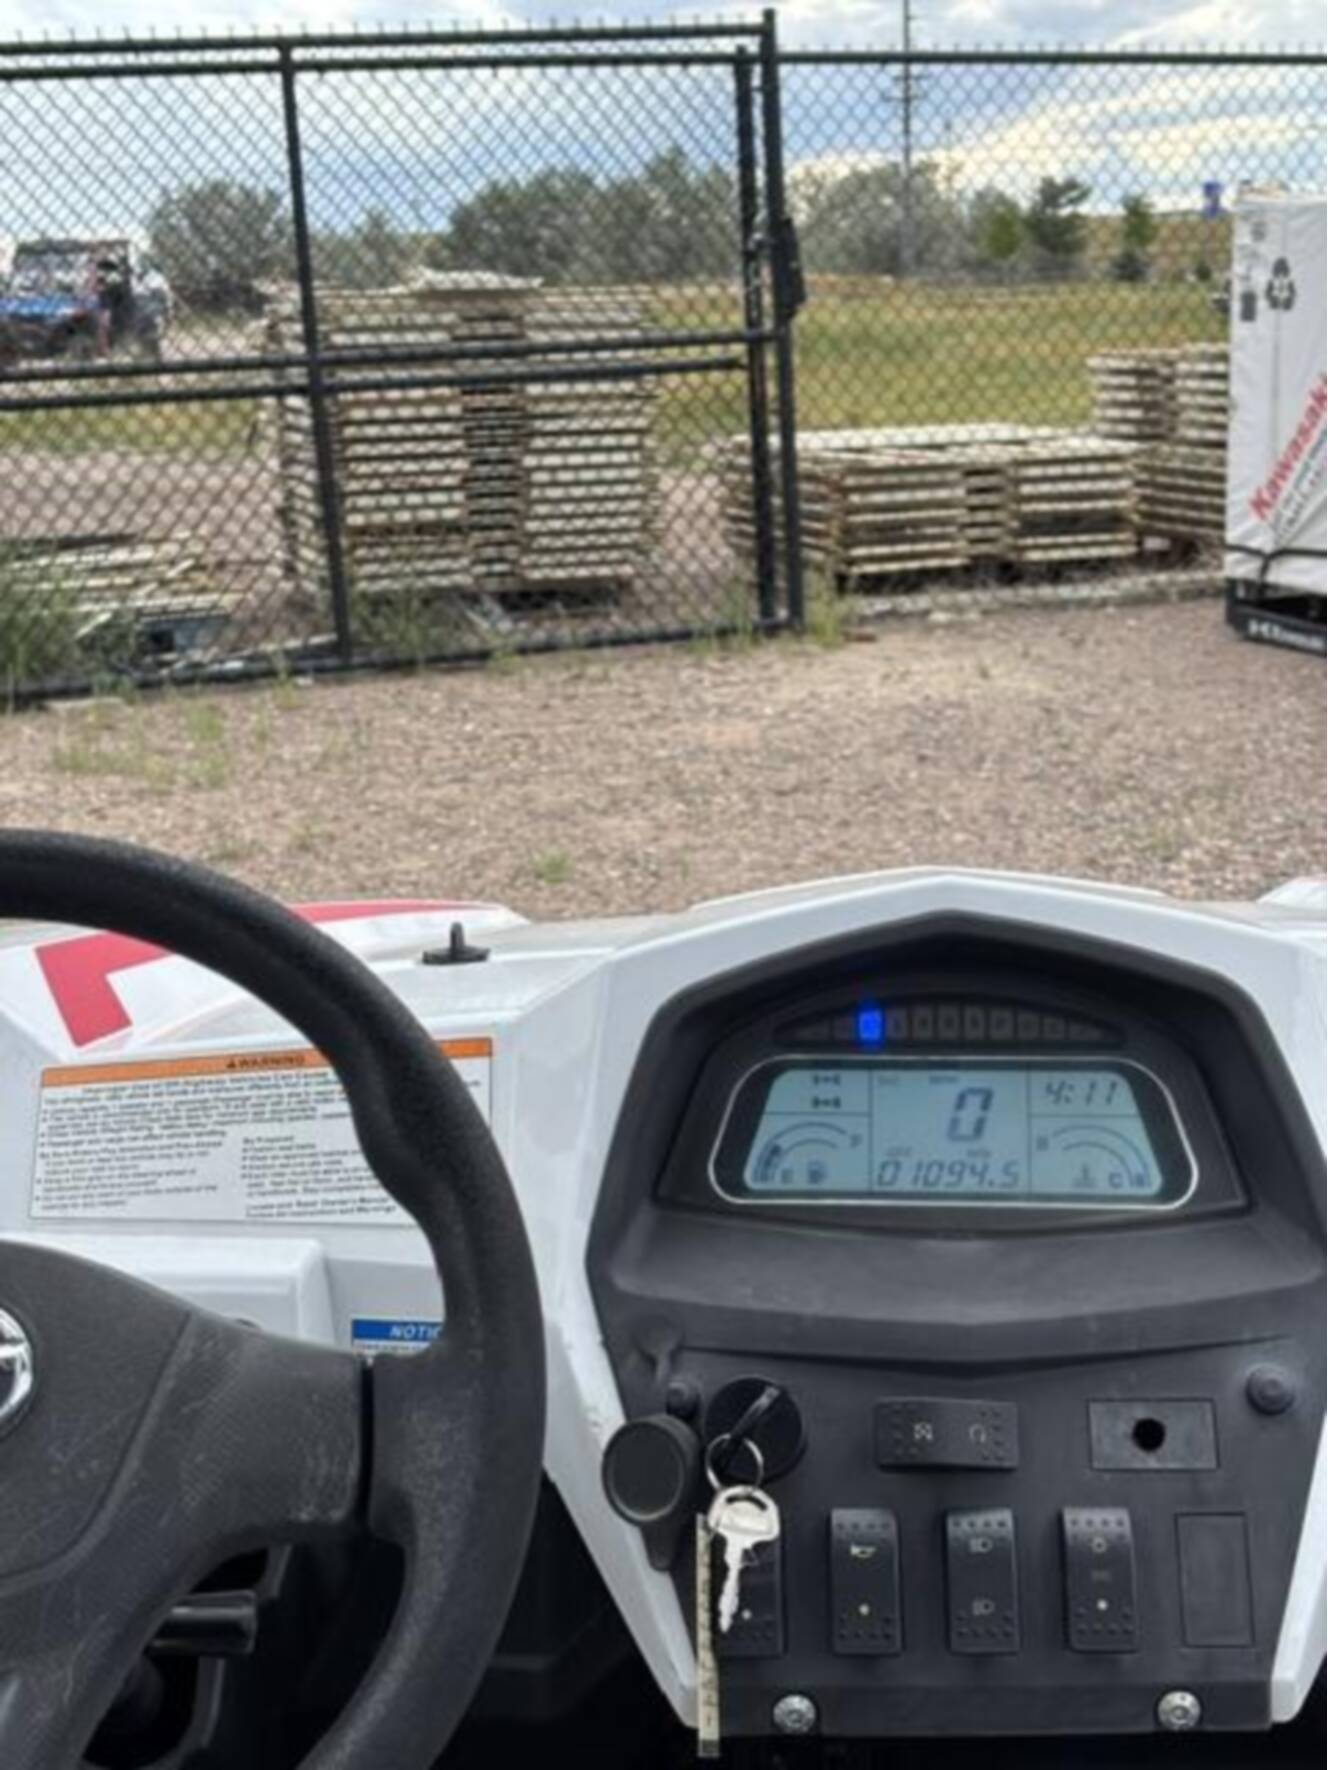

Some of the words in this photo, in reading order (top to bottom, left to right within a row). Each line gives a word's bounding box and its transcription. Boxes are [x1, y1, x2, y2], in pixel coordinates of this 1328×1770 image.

[1250, 374, 1328, 520] Kawasak
[239, 1055, 306, 1070] WARNING
[1045, 1079, 1117, 1106] 4:11
[948, 1087, 994, 1141] 0
[877, 1160, 1020, 1188] 01094.5
[389, 1324, 443, 1340] NOTIC
